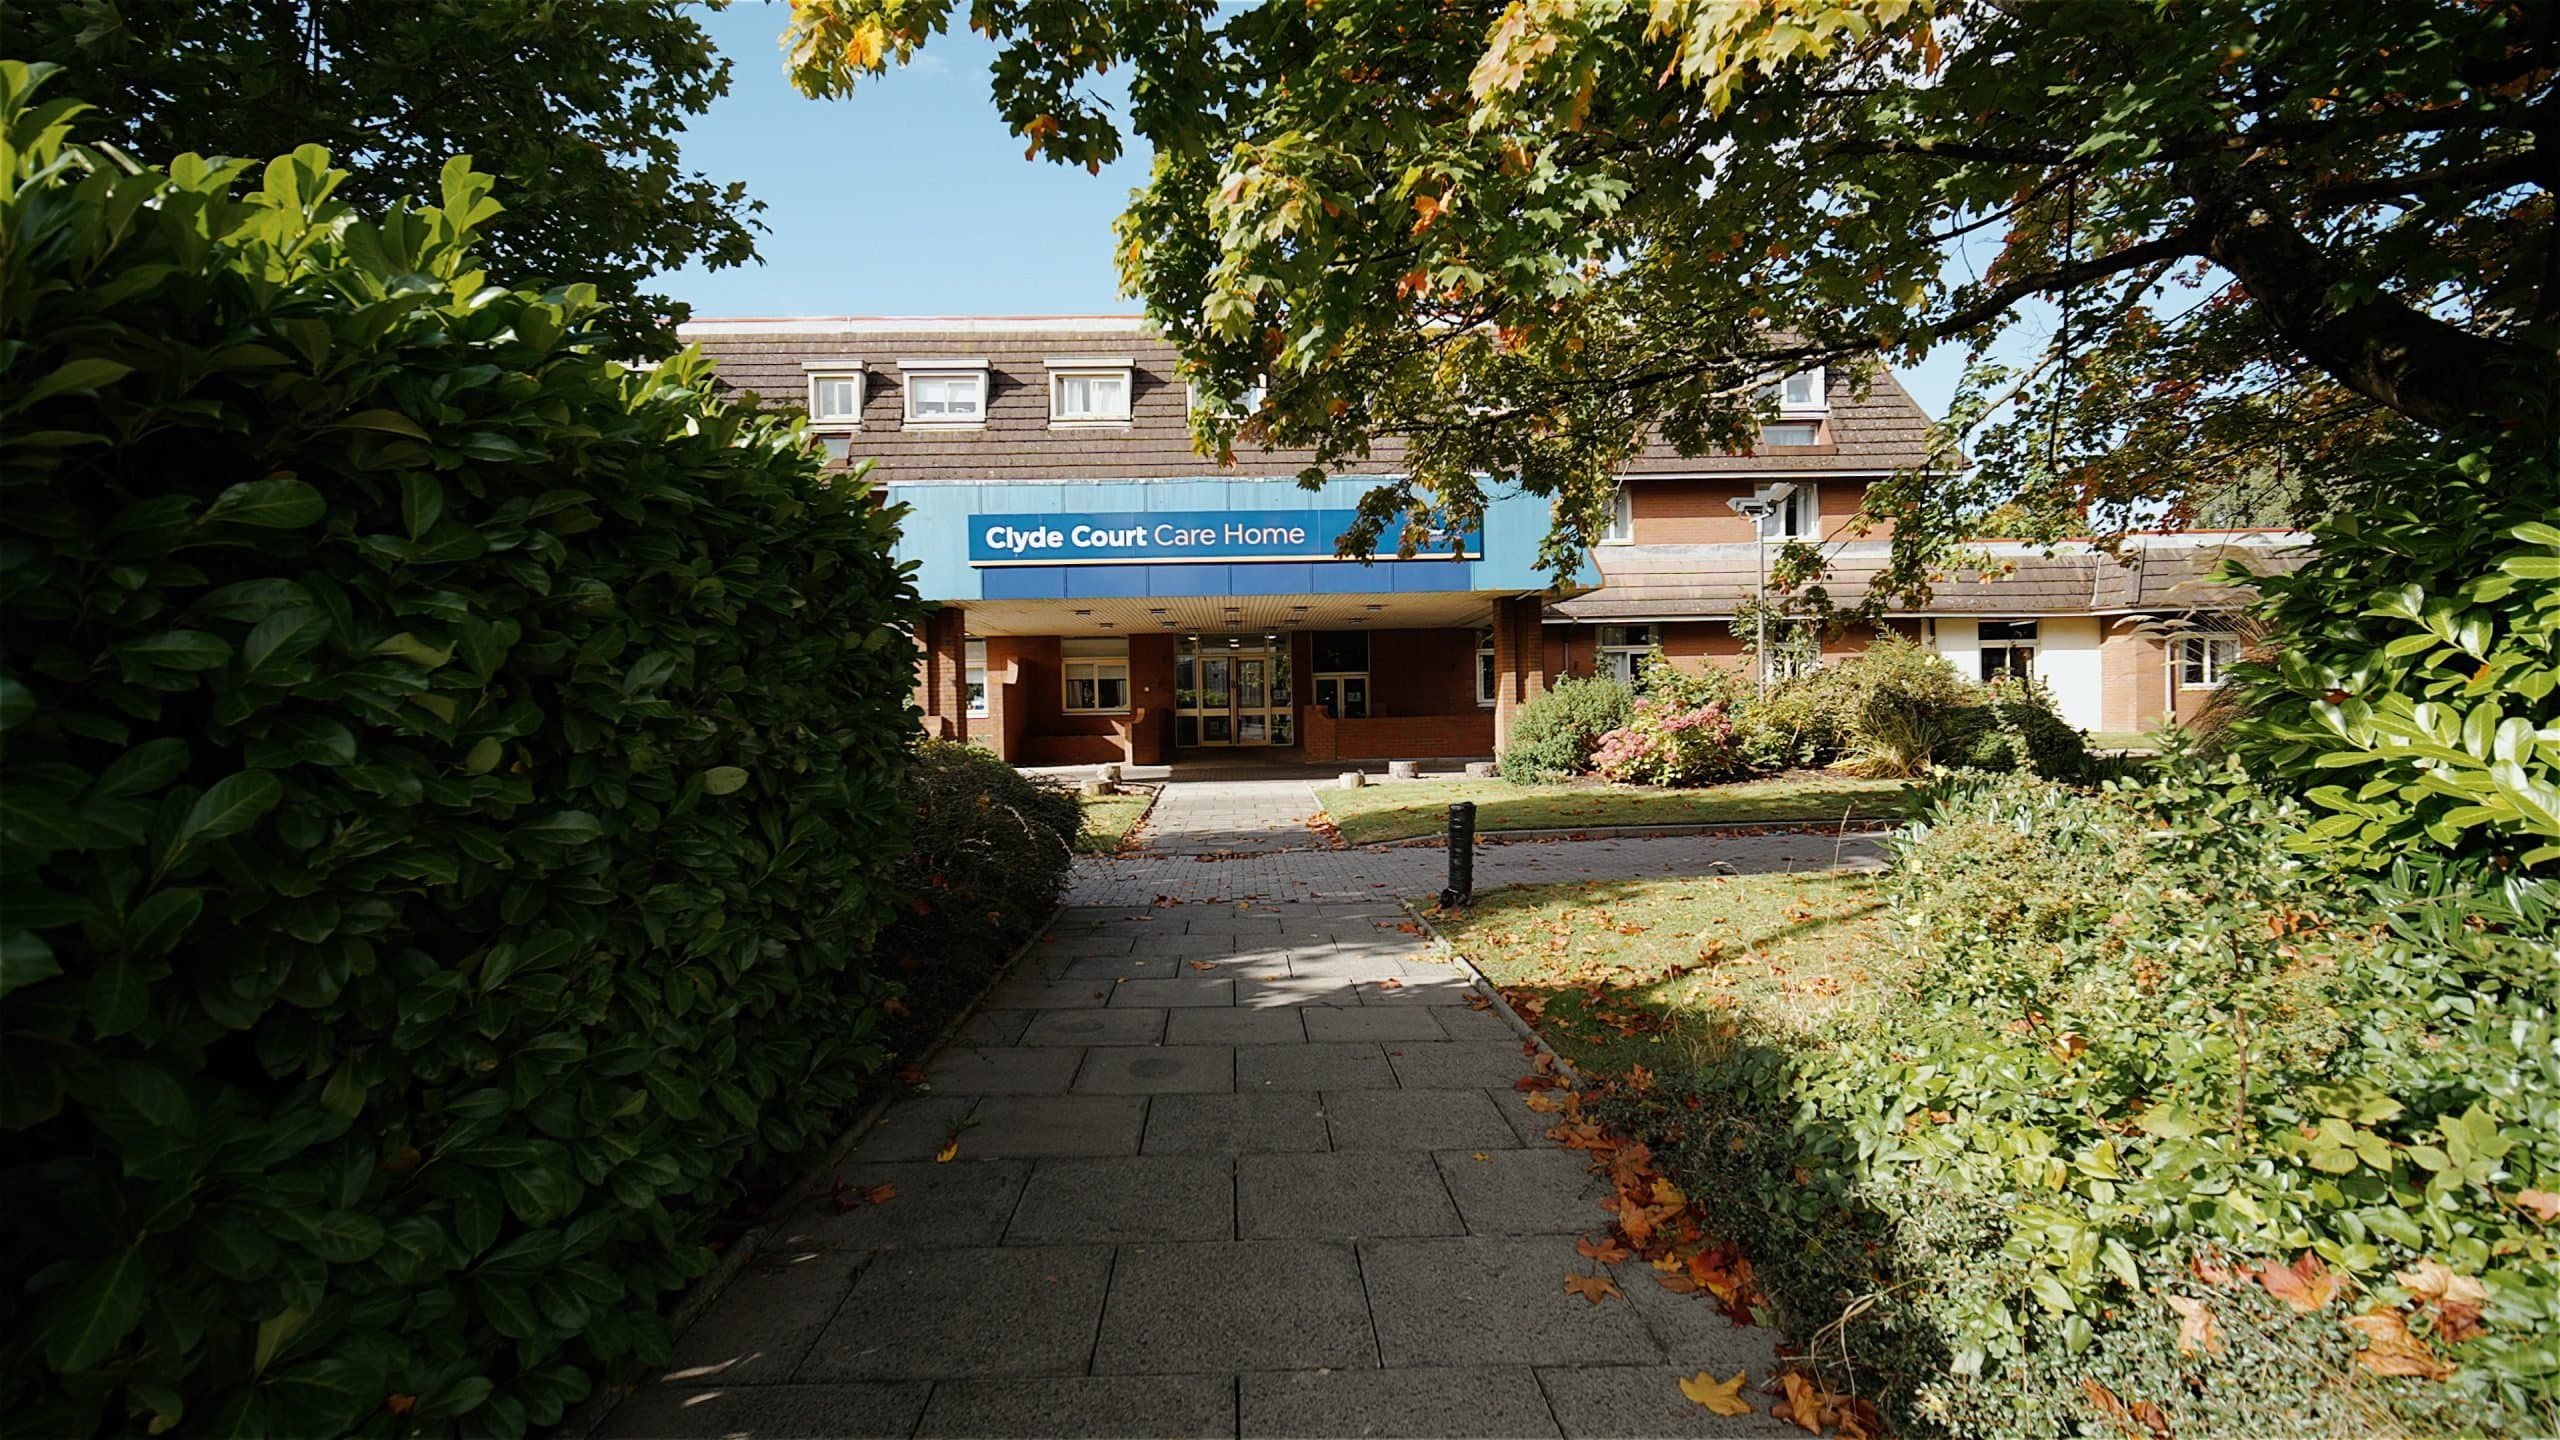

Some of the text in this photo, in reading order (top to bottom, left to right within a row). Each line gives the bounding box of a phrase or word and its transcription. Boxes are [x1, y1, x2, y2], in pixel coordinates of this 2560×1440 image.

[986, 523, 1305, 553] Clyde Court Care Home
